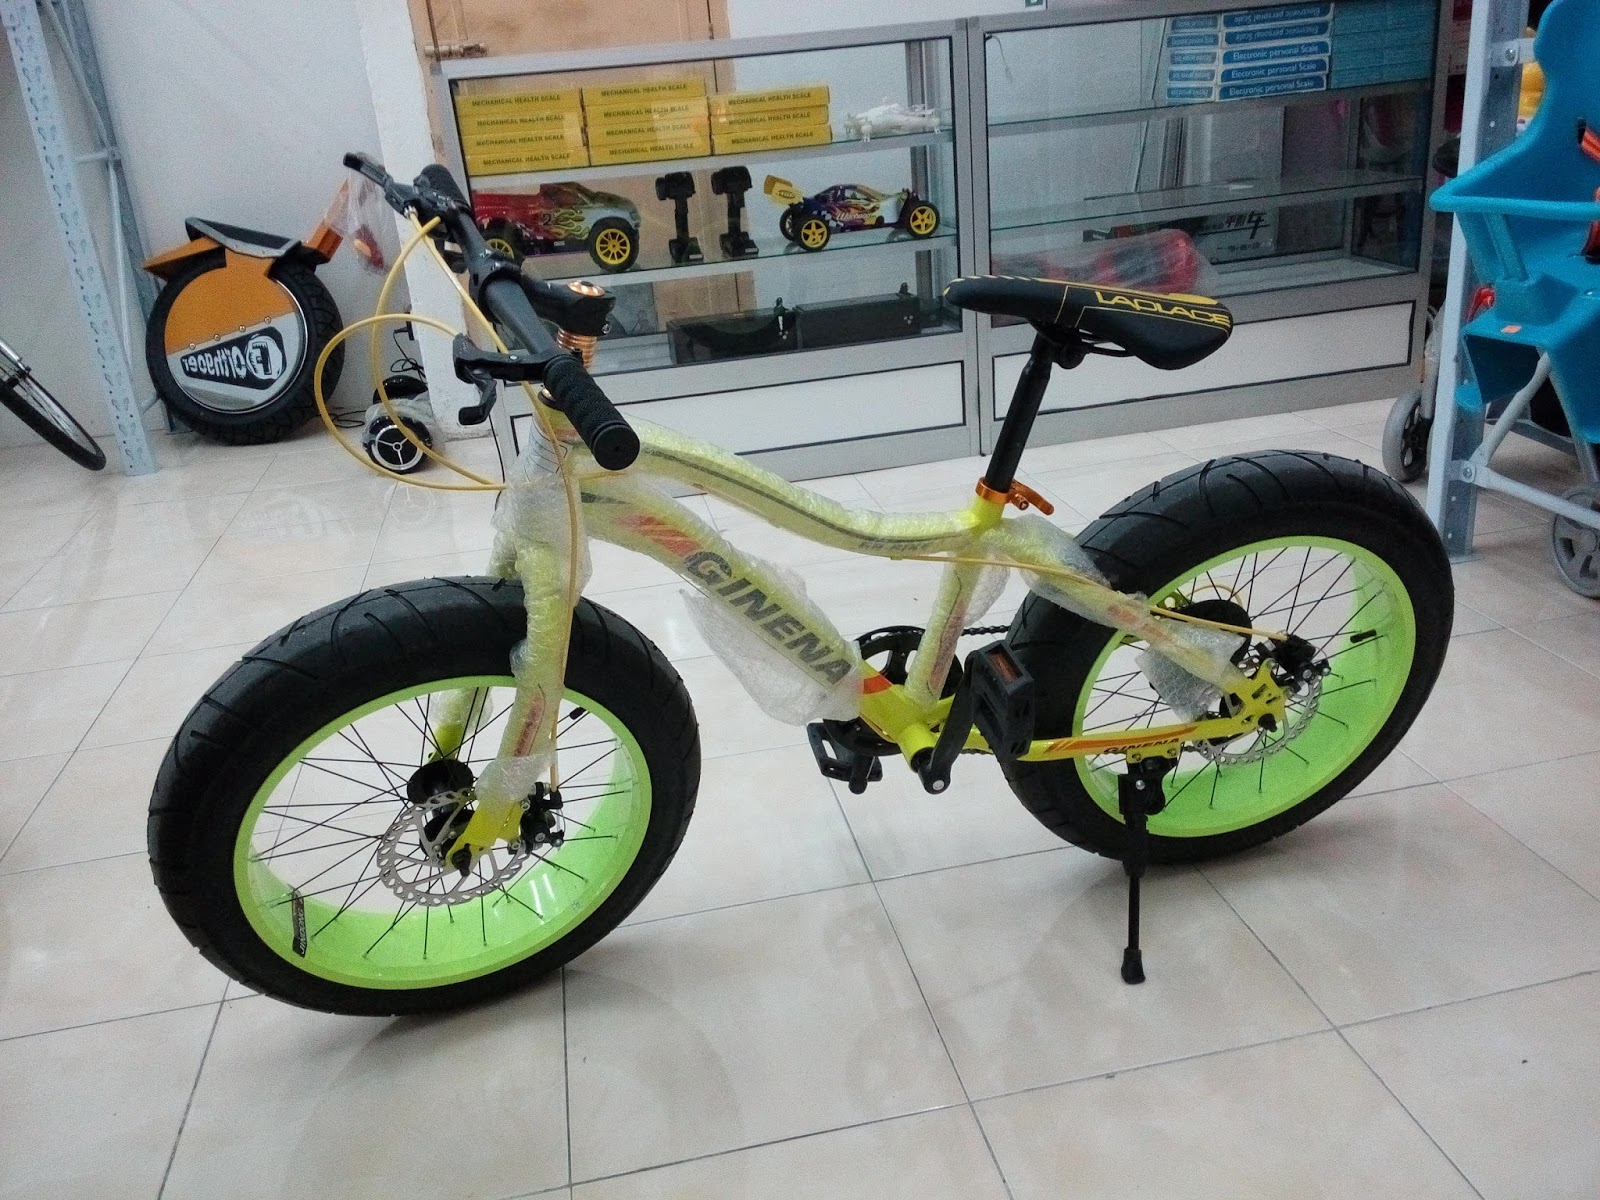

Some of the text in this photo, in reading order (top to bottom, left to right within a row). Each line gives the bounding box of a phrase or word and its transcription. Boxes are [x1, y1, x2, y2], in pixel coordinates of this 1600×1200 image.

[1233, 43, 1319, 60] Electronic personal Scale
[1231, 61, 1317, 79] Electronic personal Scale
[601, 83, 687, 97] MECHANICAL HEALTH SCALE
[1229, 78, 1315, 96] Electronic personal Scale
[472, 94, 561, 107] MECHANICAL HEALTH SCALE
[603, 105, 690, 118] MECHANICAL HEALTH SCALE
[606, 127, 645, 136] MECHANICAL
[647, 125, 671, 133] HEALTH
[483, 157, 523, 166] MECHANICAL
[525, 154, 550, 163] HEALTH
[1095, 291, 1231, 327] LAPLACE
[684, 551, 855, 685] GINENA
